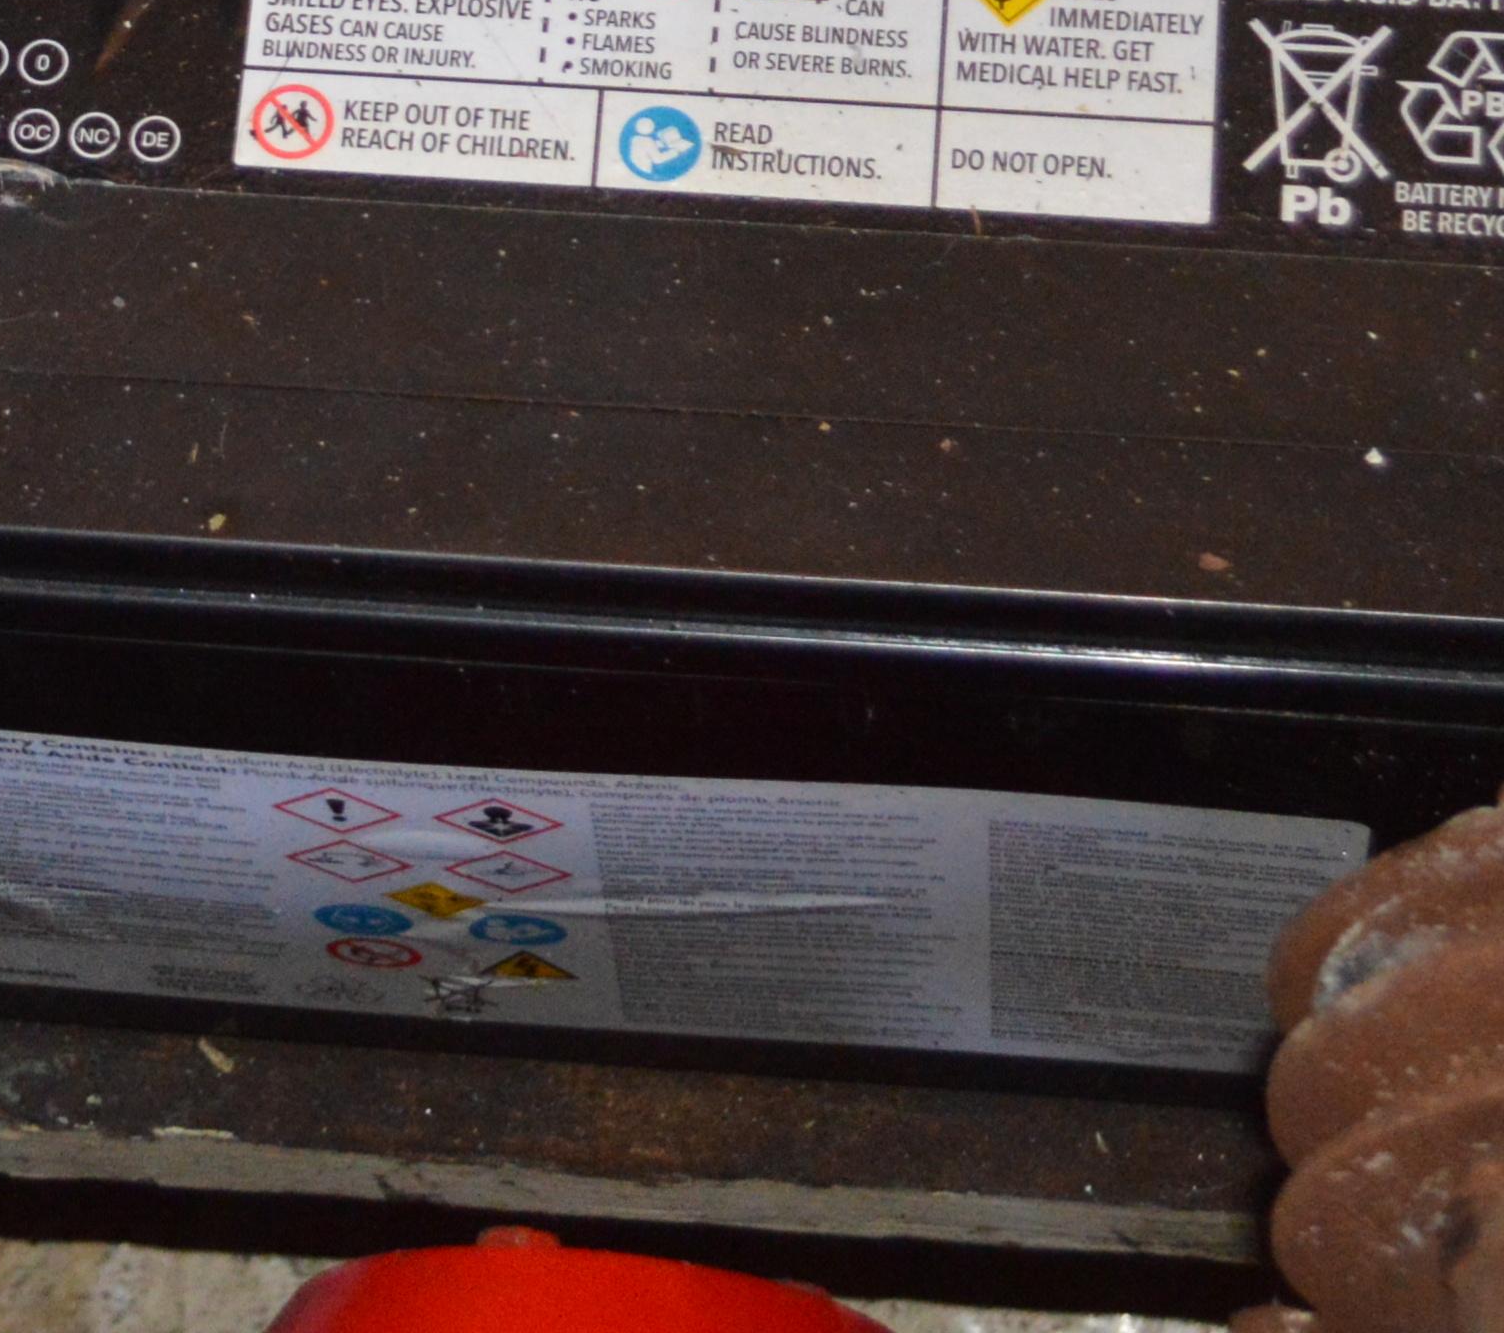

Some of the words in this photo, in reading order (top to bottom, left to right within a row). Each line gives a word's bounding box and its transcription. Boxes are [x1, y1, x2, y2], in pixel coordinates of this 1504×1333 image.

[265, 12, 333, 35] GASES
[339, 18, 377, 37] CAN
[383, 21, 443, 41] CAUSE
[584, 8, 655, 29] SPARKS
[1049, 7, 1203, 34] IMMEDIATELY
[582, 33, 654, 54] FLAMES
[734, 20, 795, 42] CAUSE
[801, 24, 907, 48] BLINDNESS
[957, 28, 1016, 54] WITH
[1023, 34, 1105, 59] WATER.
[1112, 39, 1153, 61] GET
[261, 38, 366, 62] BLINDNESS
[371, 44, 398, 63] OR
[404, 47, 477, 67] INJURY.
[732, 50, 760, 69] OR
[765, 52, 834, 73] SEVERE
[840, 56, 911, 77] BURNS.
[579, 56, 671, 80] SMOKING
[956, 60, 1057, 89] MEDICAL
[1063, 67, 1120, 89] HELP
[1127, 70, 1181, 93] FAST.
[343, 100, 398, 122] KEEP
[404, 103, 449, 125] OUT
[454, 106, 483, 127] OF
[489, 108, 529, 130] THE
[340, 126, 414, 150] REACH
[420, 131, 449, 152] OF
[456, 133, 574, 160] CHILDREN.
[714, 121, 772, 144] READ
[711, 147, 881, 179] INSTRUCTIONS.
[951, 148, 984, 170] DO
[992, 150, 1037, 173] NOT
[1042, 153, 1111, 179] OPEN.
[1280, 184, 1352, 226] Pb
[1394, 181, 1492, 207] BATTERY
[1402, 209, 1431, 232] BE
